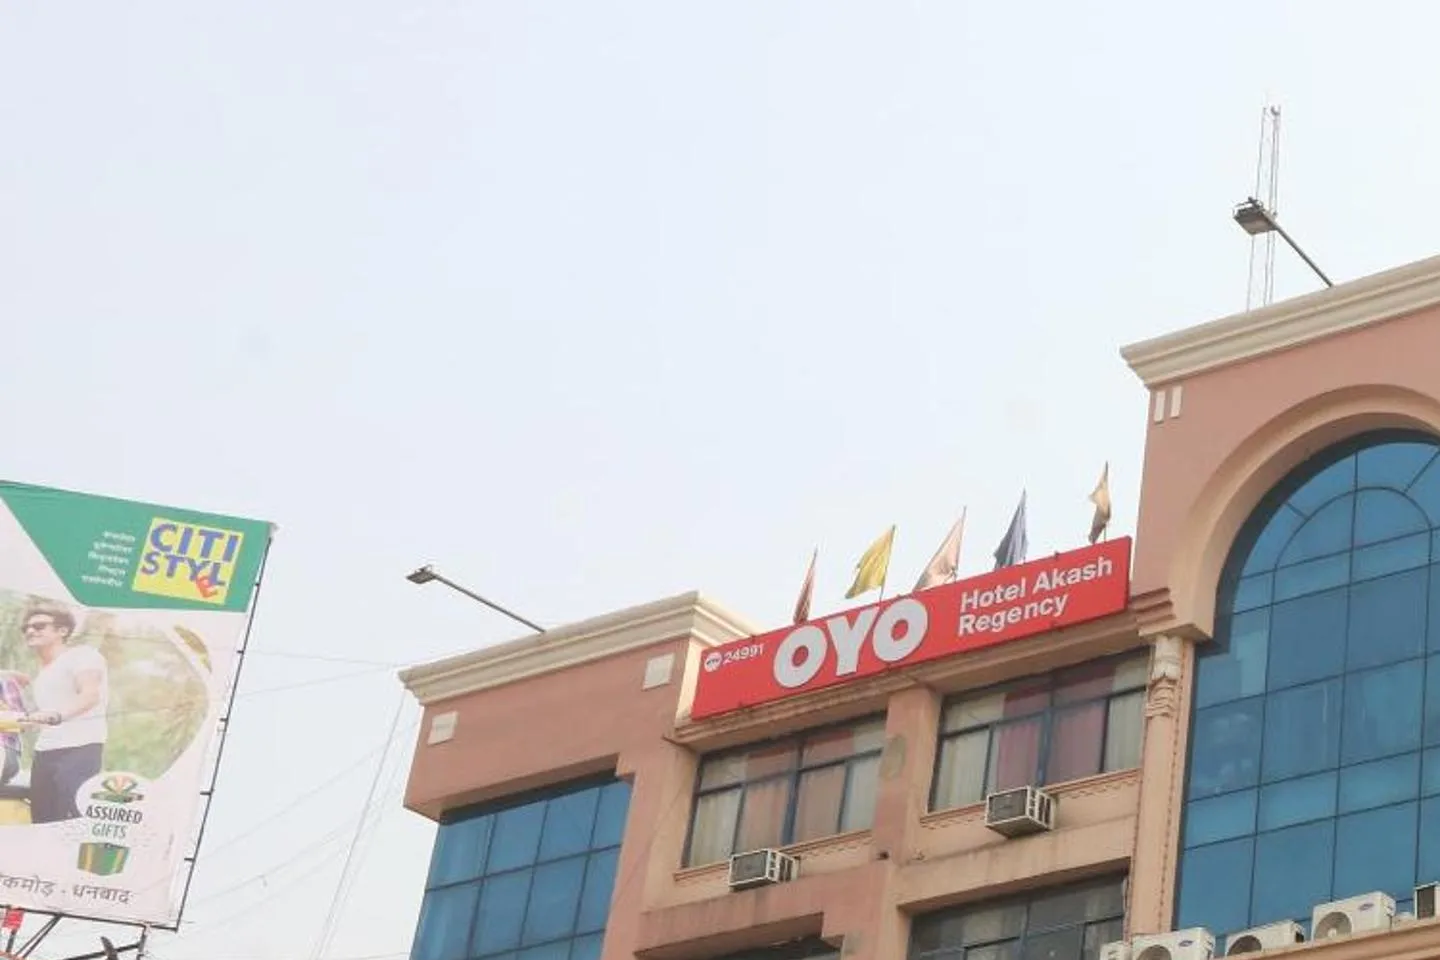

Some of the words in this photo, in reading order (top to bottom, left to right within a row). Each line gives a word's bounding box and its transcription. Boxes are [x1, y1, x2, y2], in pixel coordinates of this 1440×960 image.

[150, 523, 240, 562] CITI
[960, 582, 1027, 613] Hotel
[1032, 556, 1113, 594] Akash
[958, 593, 1068, 637] Regency
[773, 598, 929, 688] OYO
[86, 805, 143, 824] ASSURED
[92, 823, 128, 839] GIFTS
